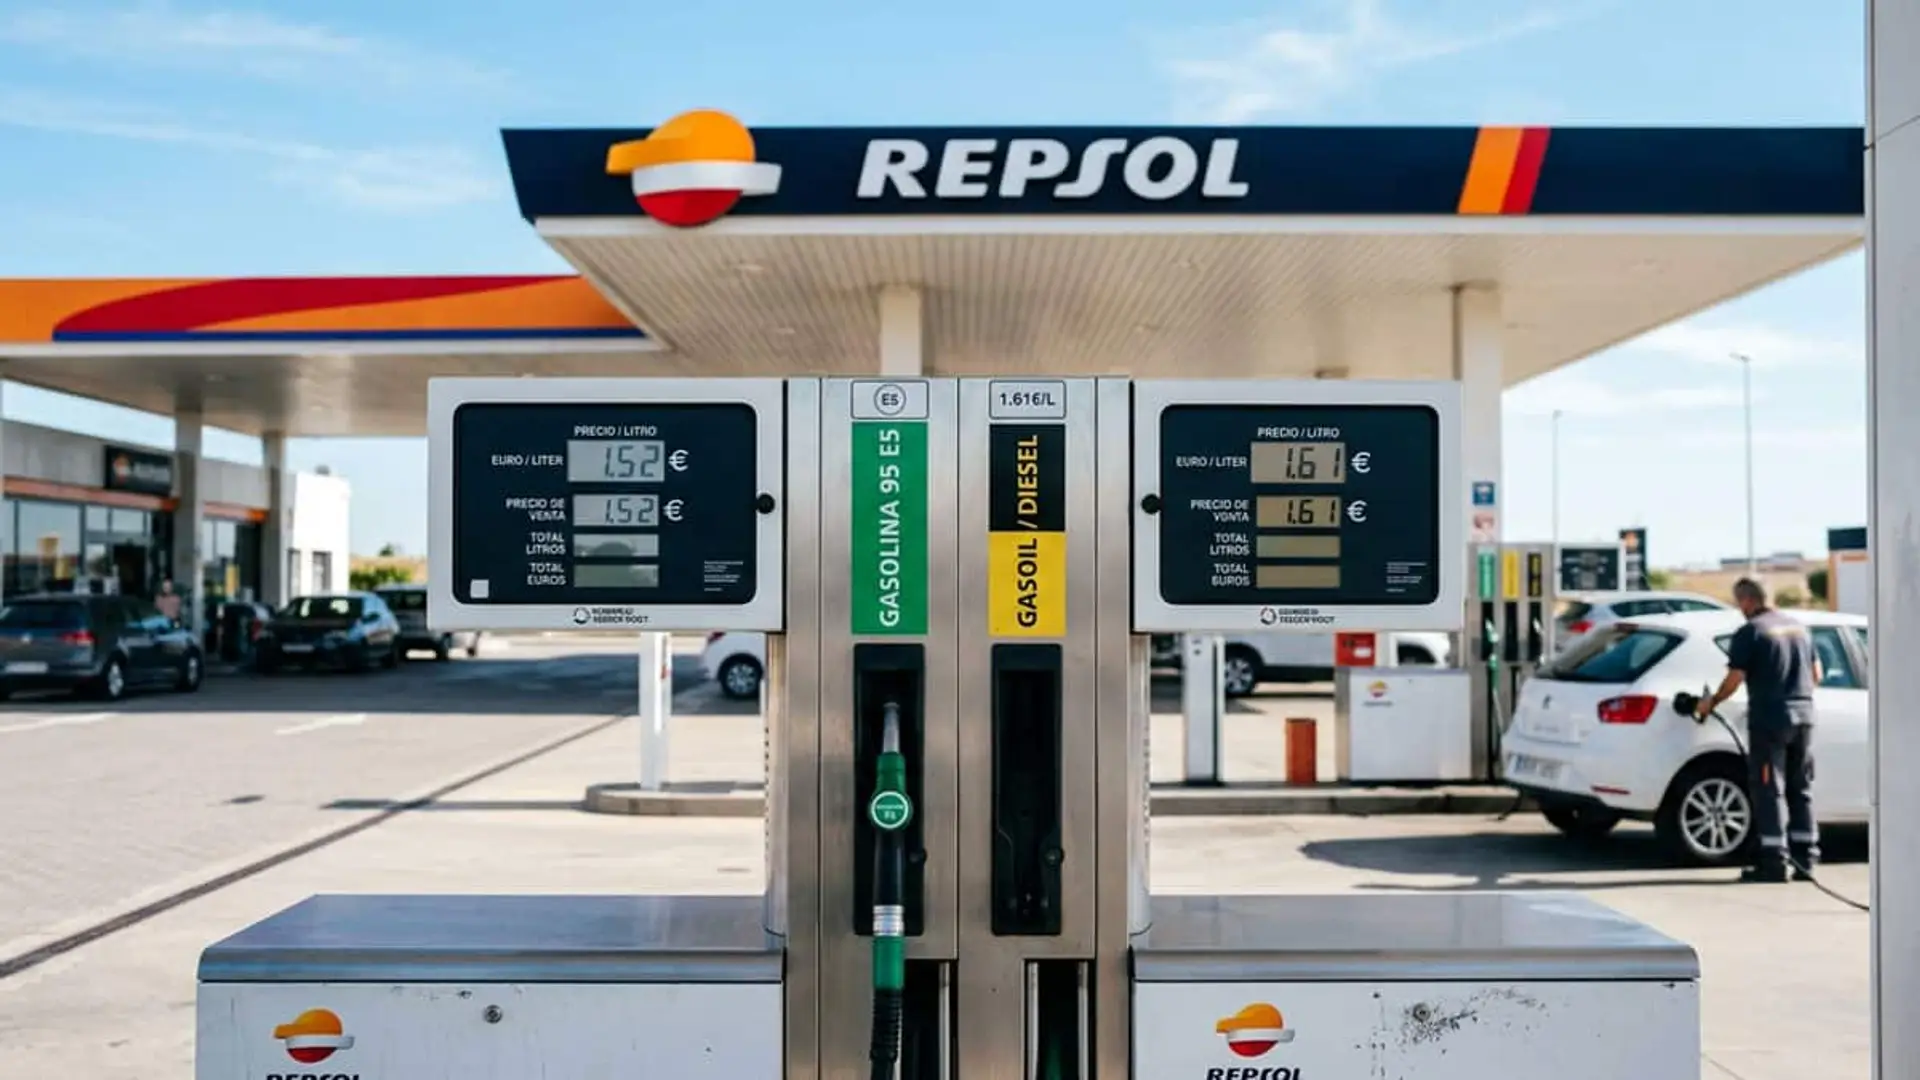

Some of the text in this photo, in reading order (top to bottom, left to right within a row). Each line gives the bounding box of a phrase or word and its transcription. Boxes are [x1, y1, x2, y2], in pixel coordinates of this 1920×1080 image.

[857, 136, 1249, 198] REPSOL
[881, 393, 899, 406] E5
[1017, 435, 1038, 515] DIESEL
[879, 428, 900, 627] GASOLINA 95 E5
[530, 531, 565, 542] TOTAL
[1214, 532, 1249, 543] TOTAL
[529, 562, 564, 573] TOTAL
[1214, 563, 1249, 574] TOTAL
[1017, 538, 1038, 627] GASOIL
